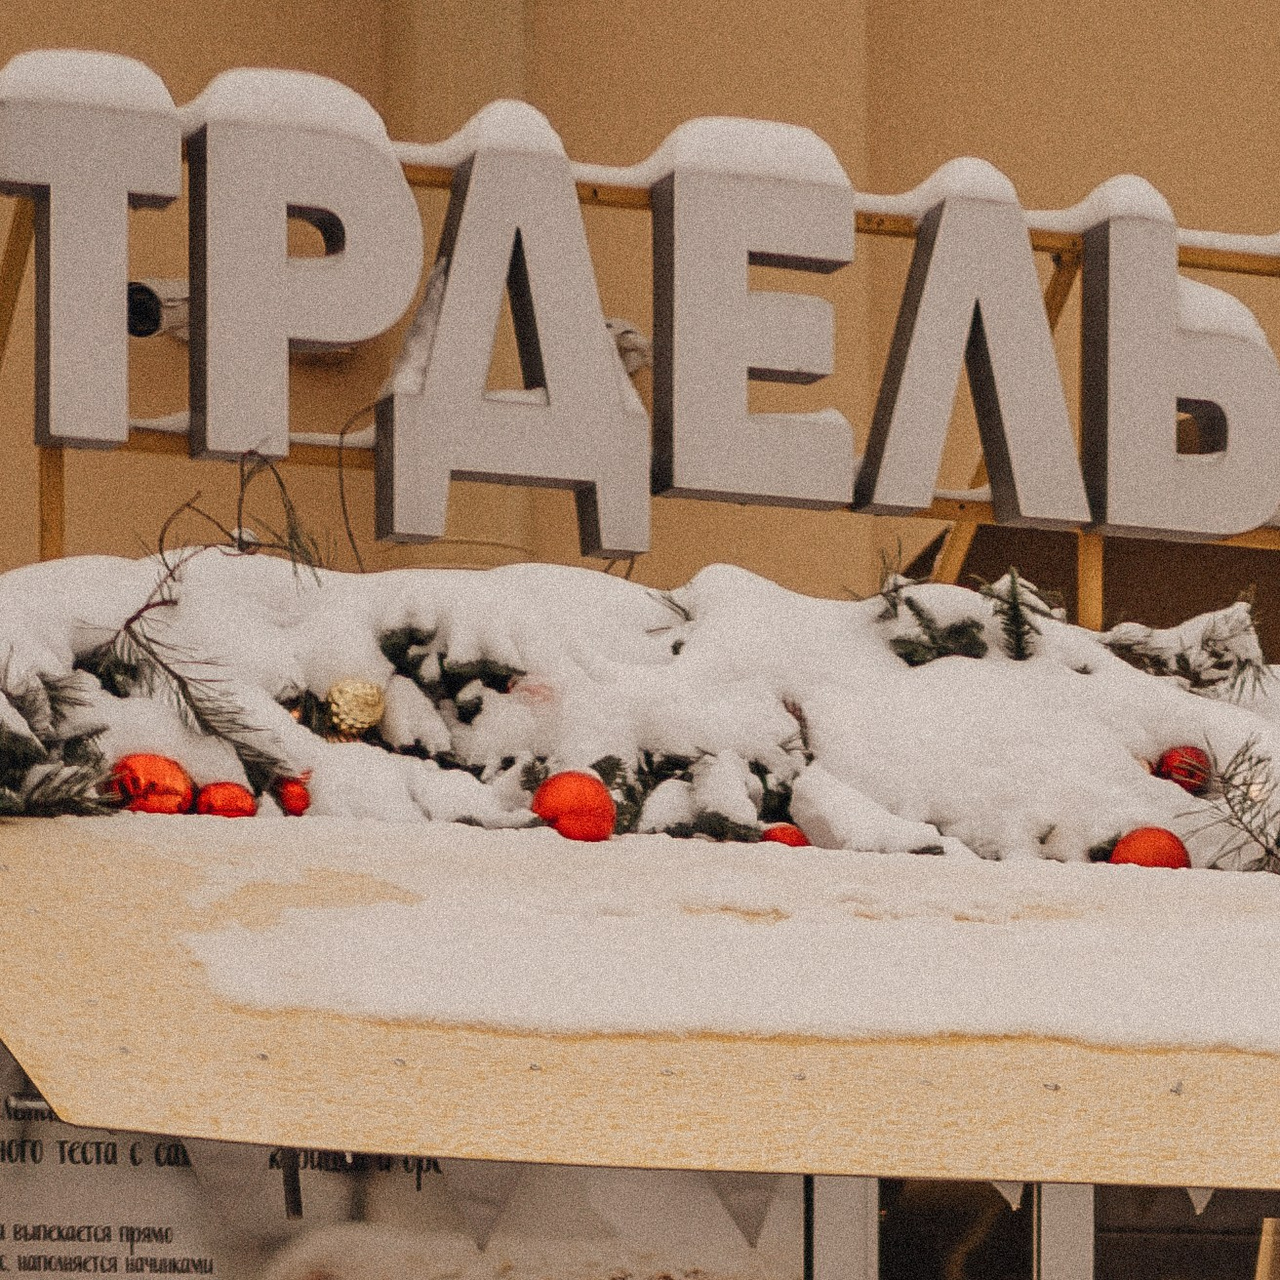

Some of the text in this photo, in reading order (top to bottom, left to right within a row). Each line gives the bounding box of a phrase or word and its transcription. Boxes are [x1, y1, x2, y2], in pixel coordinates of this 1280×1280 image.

[58, 1140, 118, 1166] теста
[130, 1141, 143, 1166] с
[13, 1223, 174, 1256] выпекается прямо
[18, 1254, 118, 1274] наполняется
[125, 1256, 214, 1275] начинками
